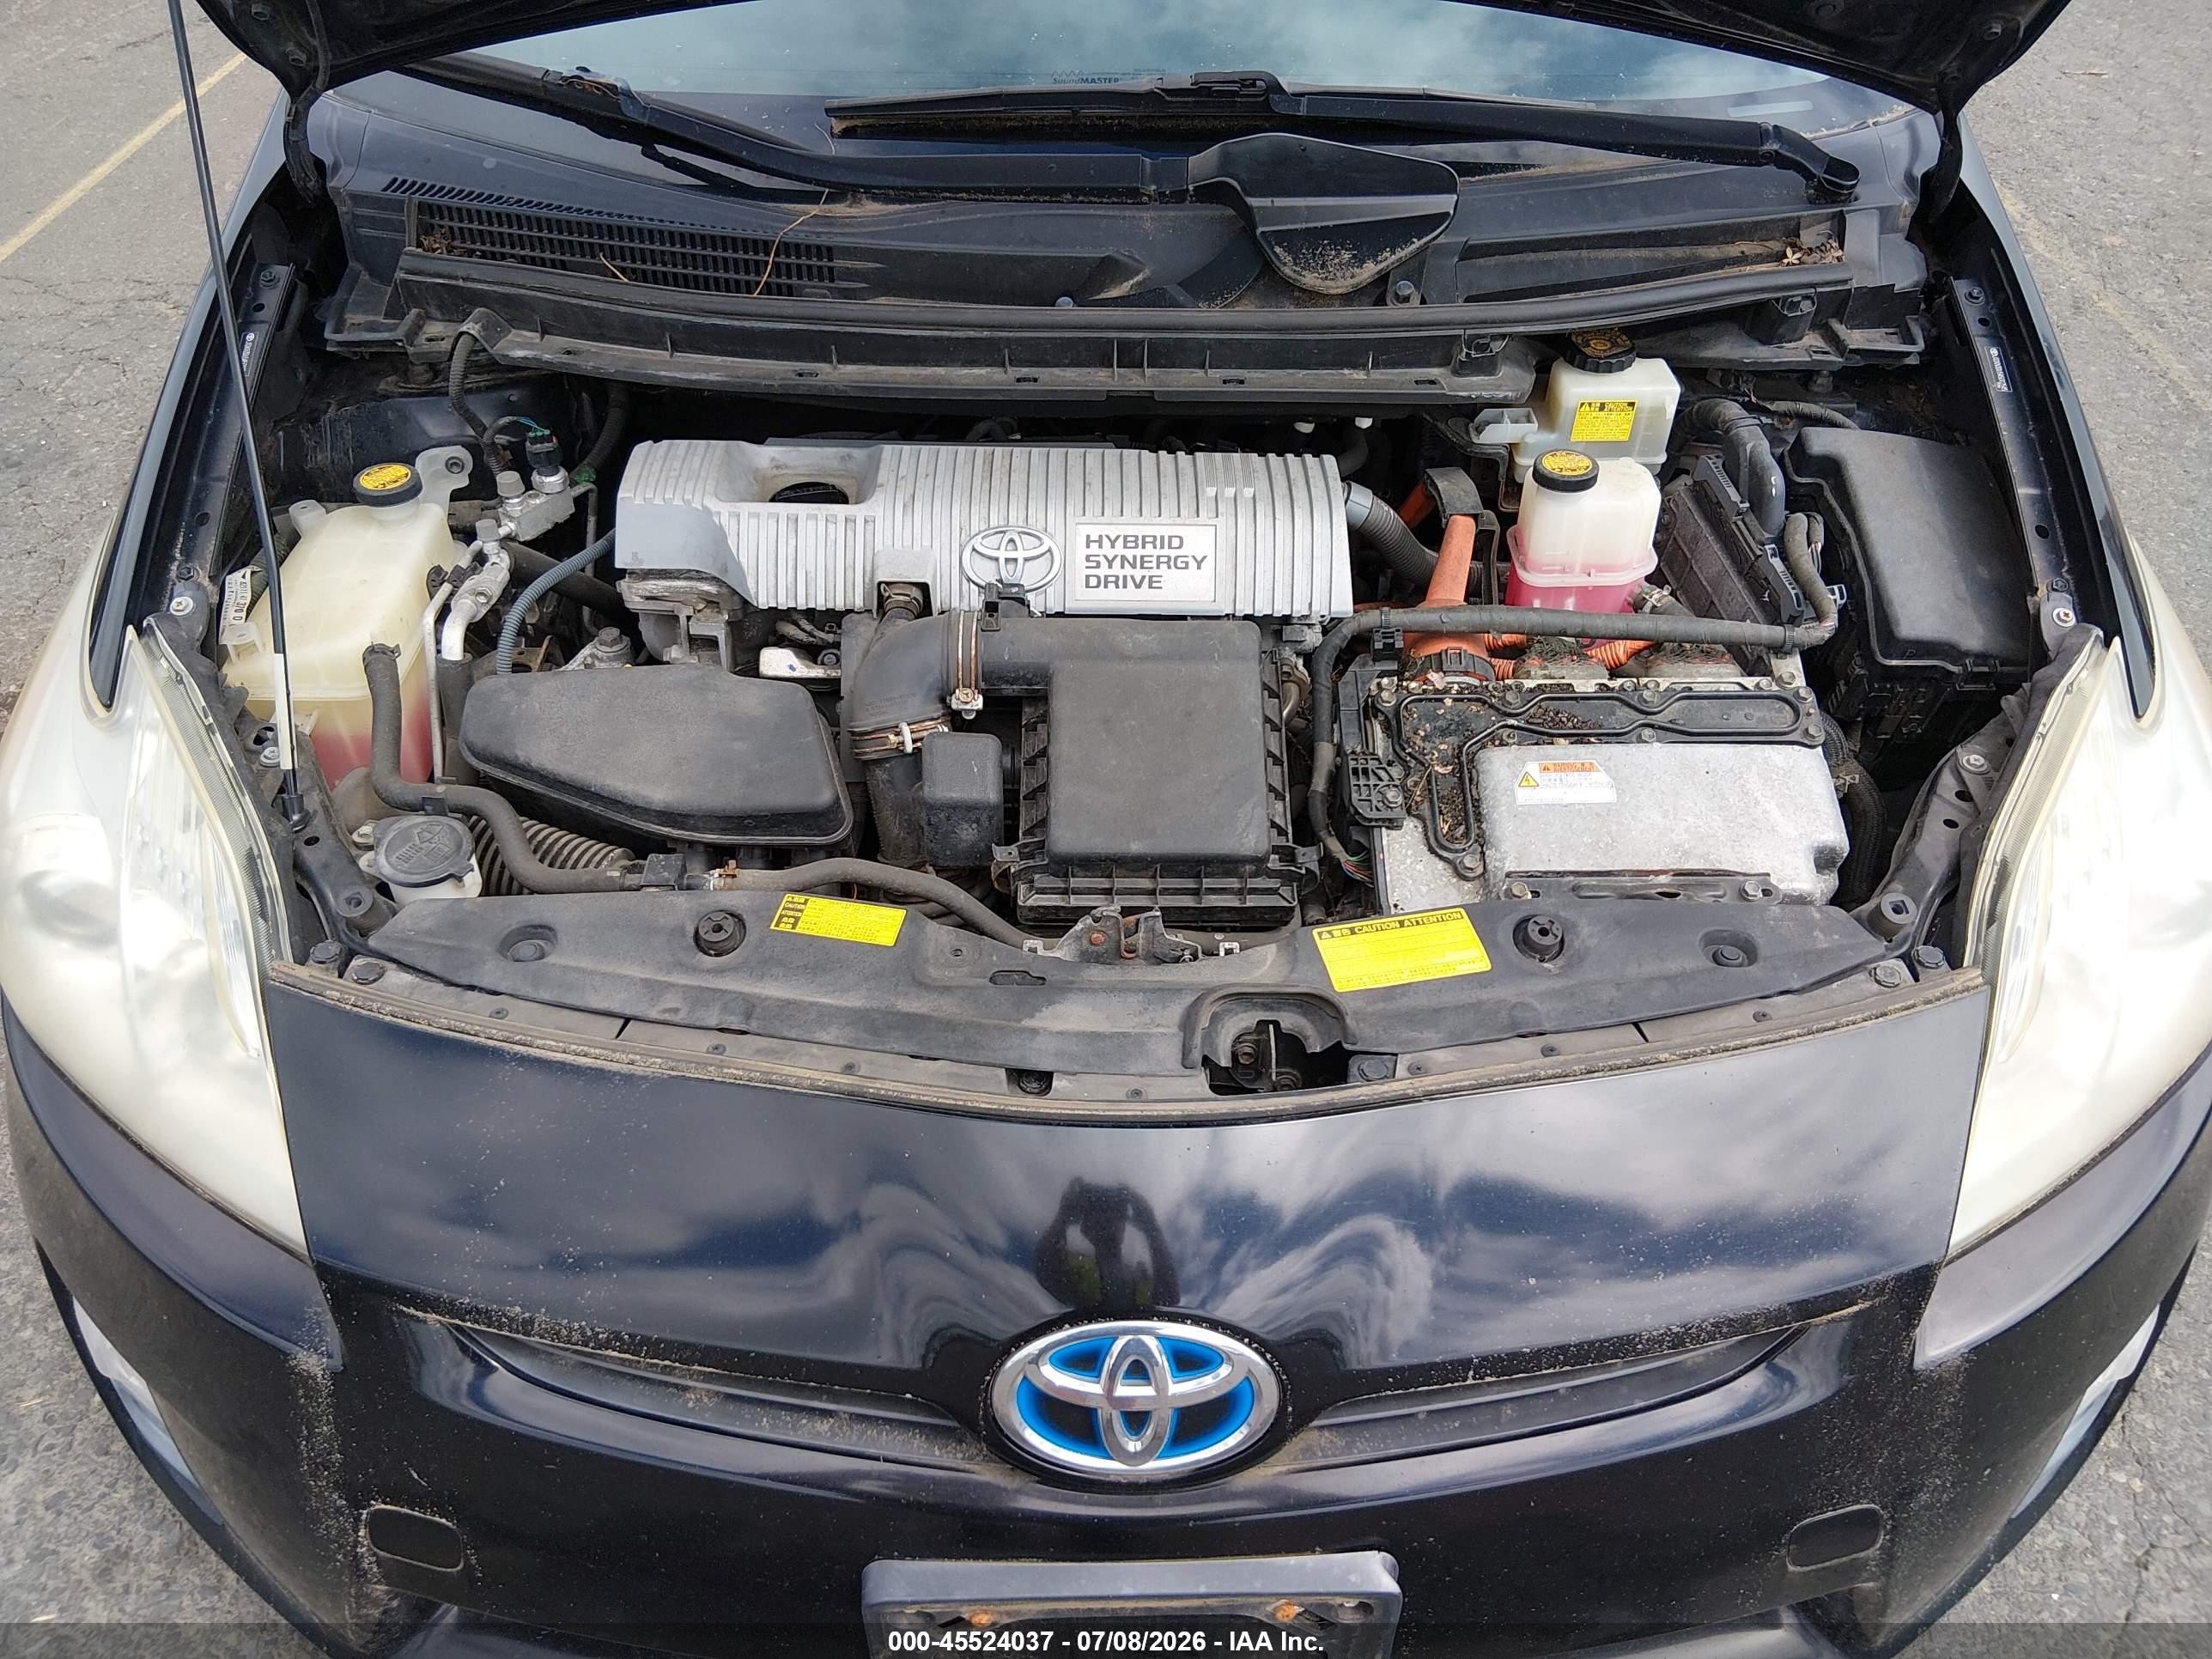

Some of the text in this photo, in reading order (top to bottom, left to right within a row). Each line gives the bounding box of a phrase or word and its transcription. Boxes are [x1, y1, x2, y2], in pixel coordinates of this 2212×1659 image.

[1085, 534, 1184, 550] HYBRID
[1085, 554, 1208, 570] SYNERGY
[1085, 574, 1164, 589] DRIVE
[1354, 920, 1401, 933] CAUTION
[1403, 911, 1462, 927] ATTENTION
